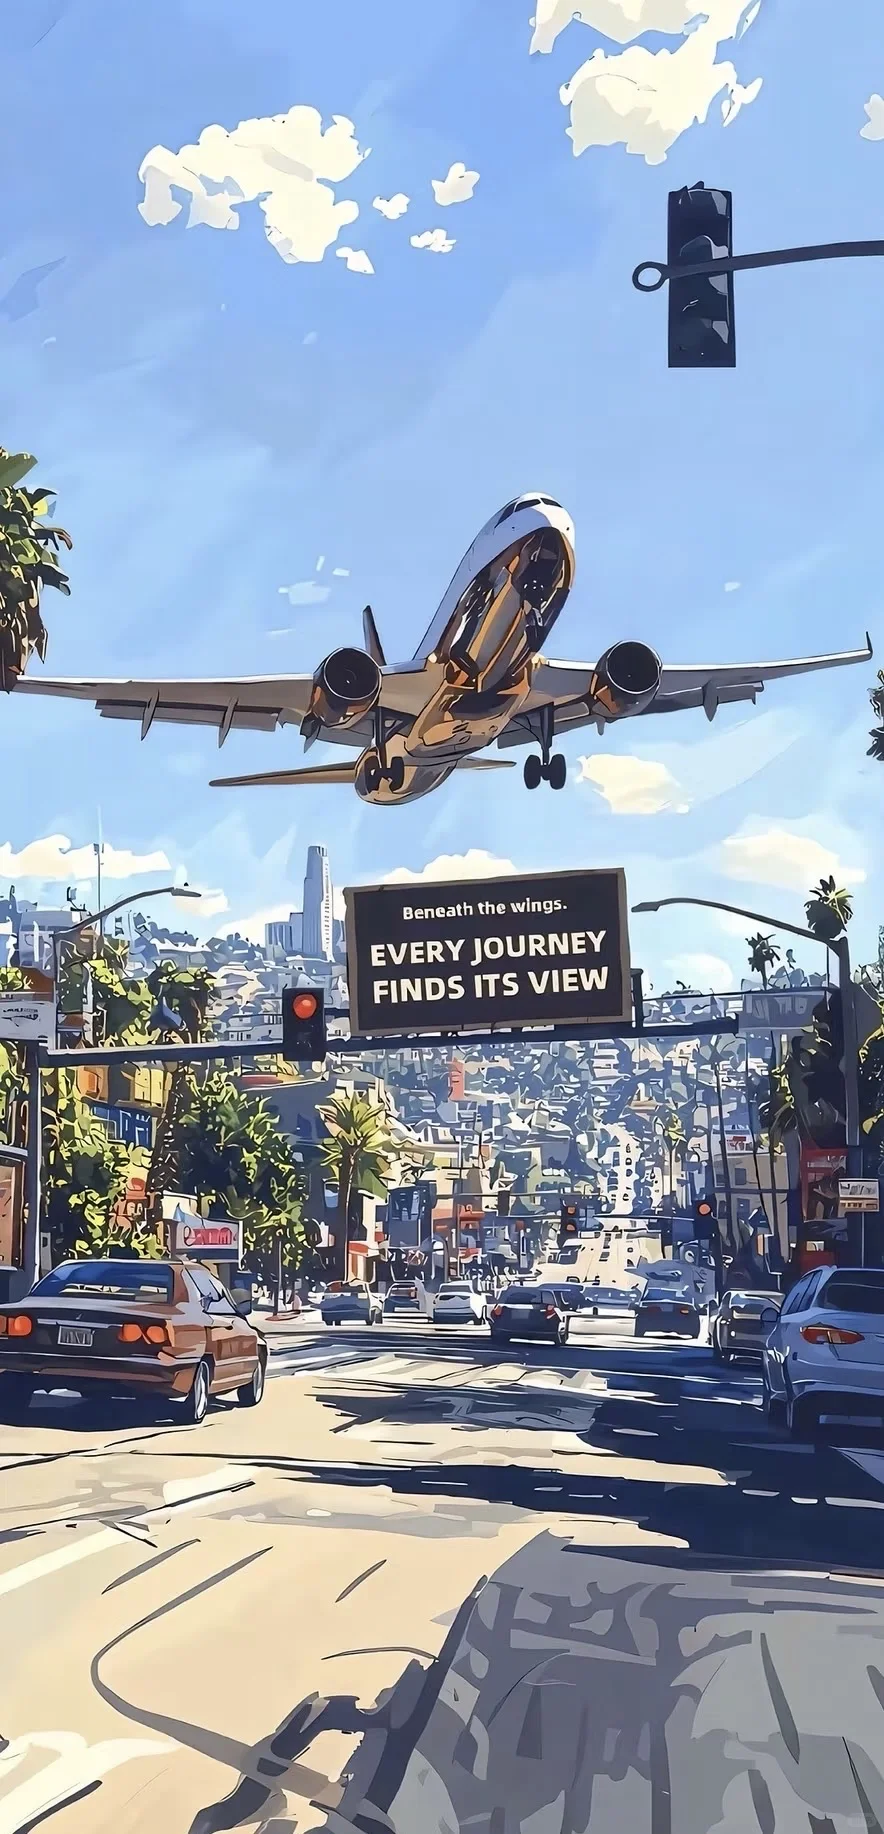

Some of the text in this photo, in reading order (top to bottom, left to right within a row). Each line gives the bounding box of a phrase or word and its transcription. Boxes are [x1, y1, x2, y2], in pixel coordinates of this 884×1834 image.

[403, 897, 567, 920] Beneath the wings.
[370, 930, 606, 967] EVERY JOURNEY
[373, 966, 608, 1004] FINDS ITS VIEW
